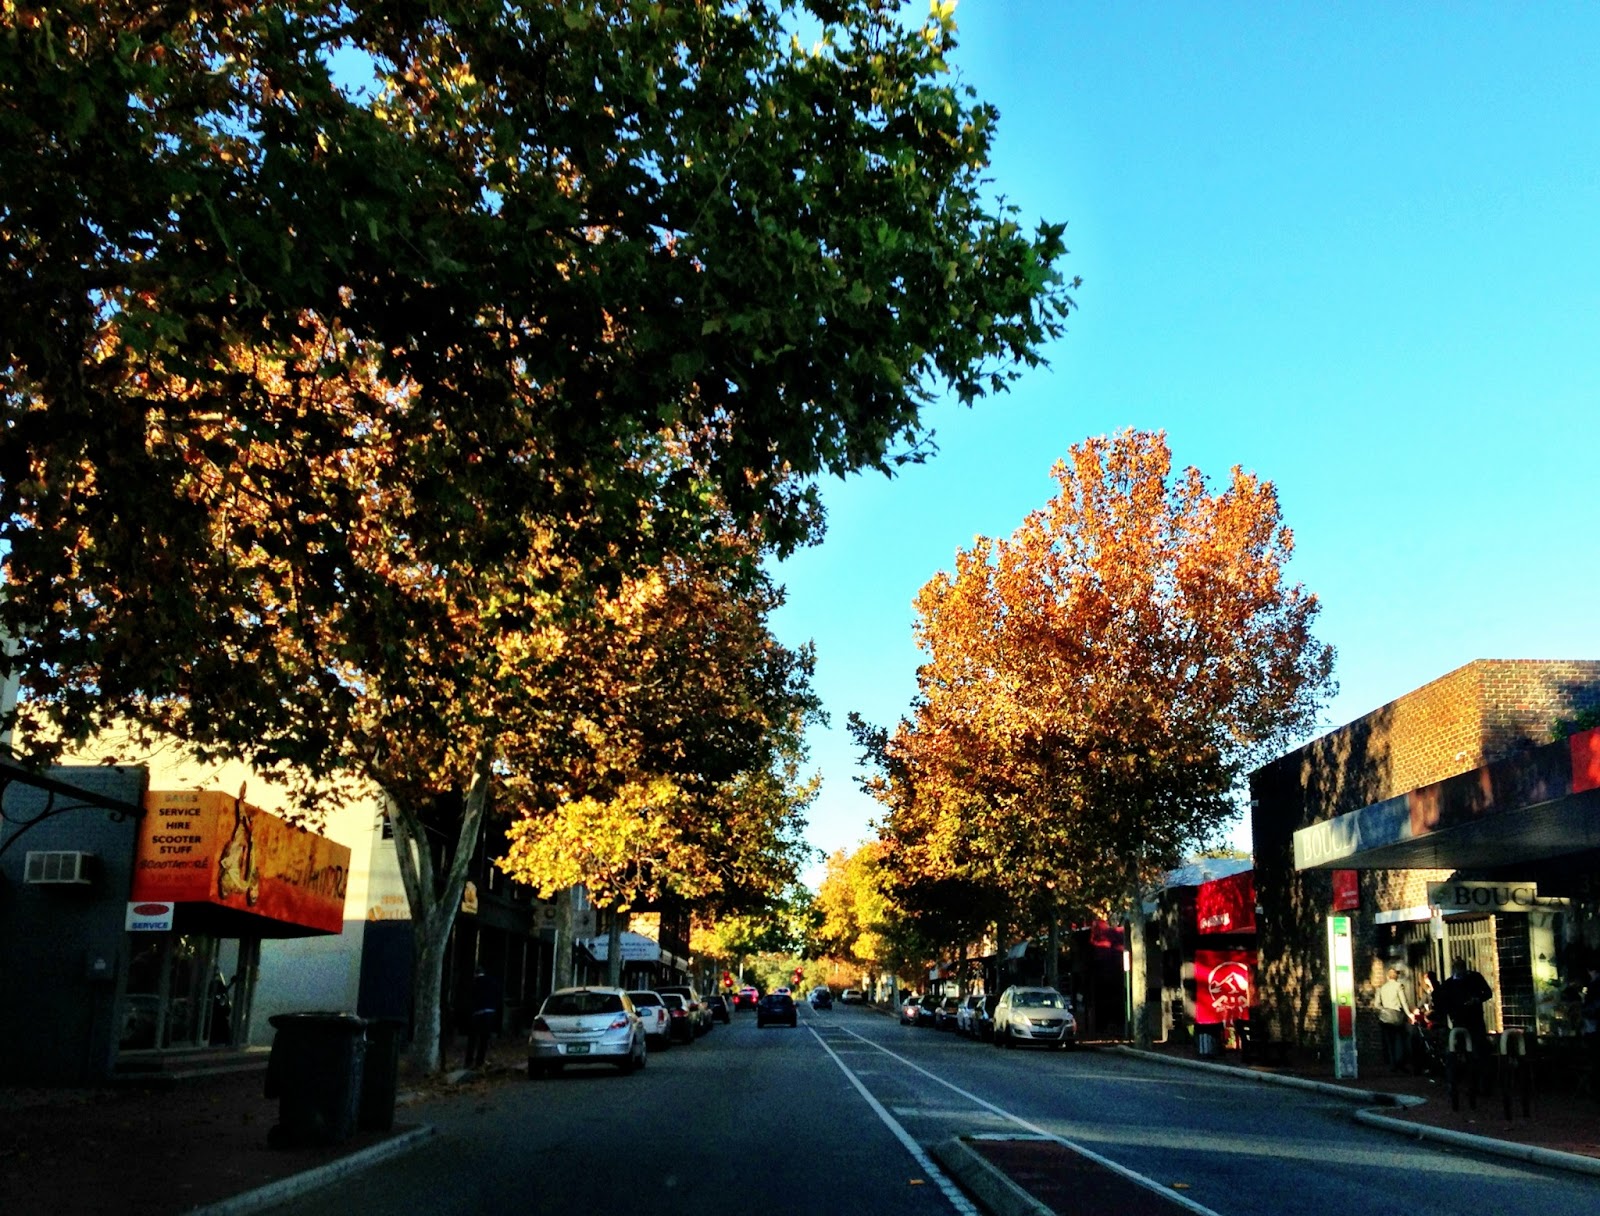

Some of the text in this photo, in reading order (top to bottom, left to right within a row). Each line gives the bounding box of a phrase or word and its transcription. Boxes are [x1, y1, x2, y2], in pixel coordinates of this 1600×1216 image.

[158, 808, 201, 817] SERVICE
[166, 821, 191, 830] HIRE
[152, 835, 202, 844] SCOOTER
[159, 846, 193, 854] STUFF
[131, 922, 169, 930] SERVICE
